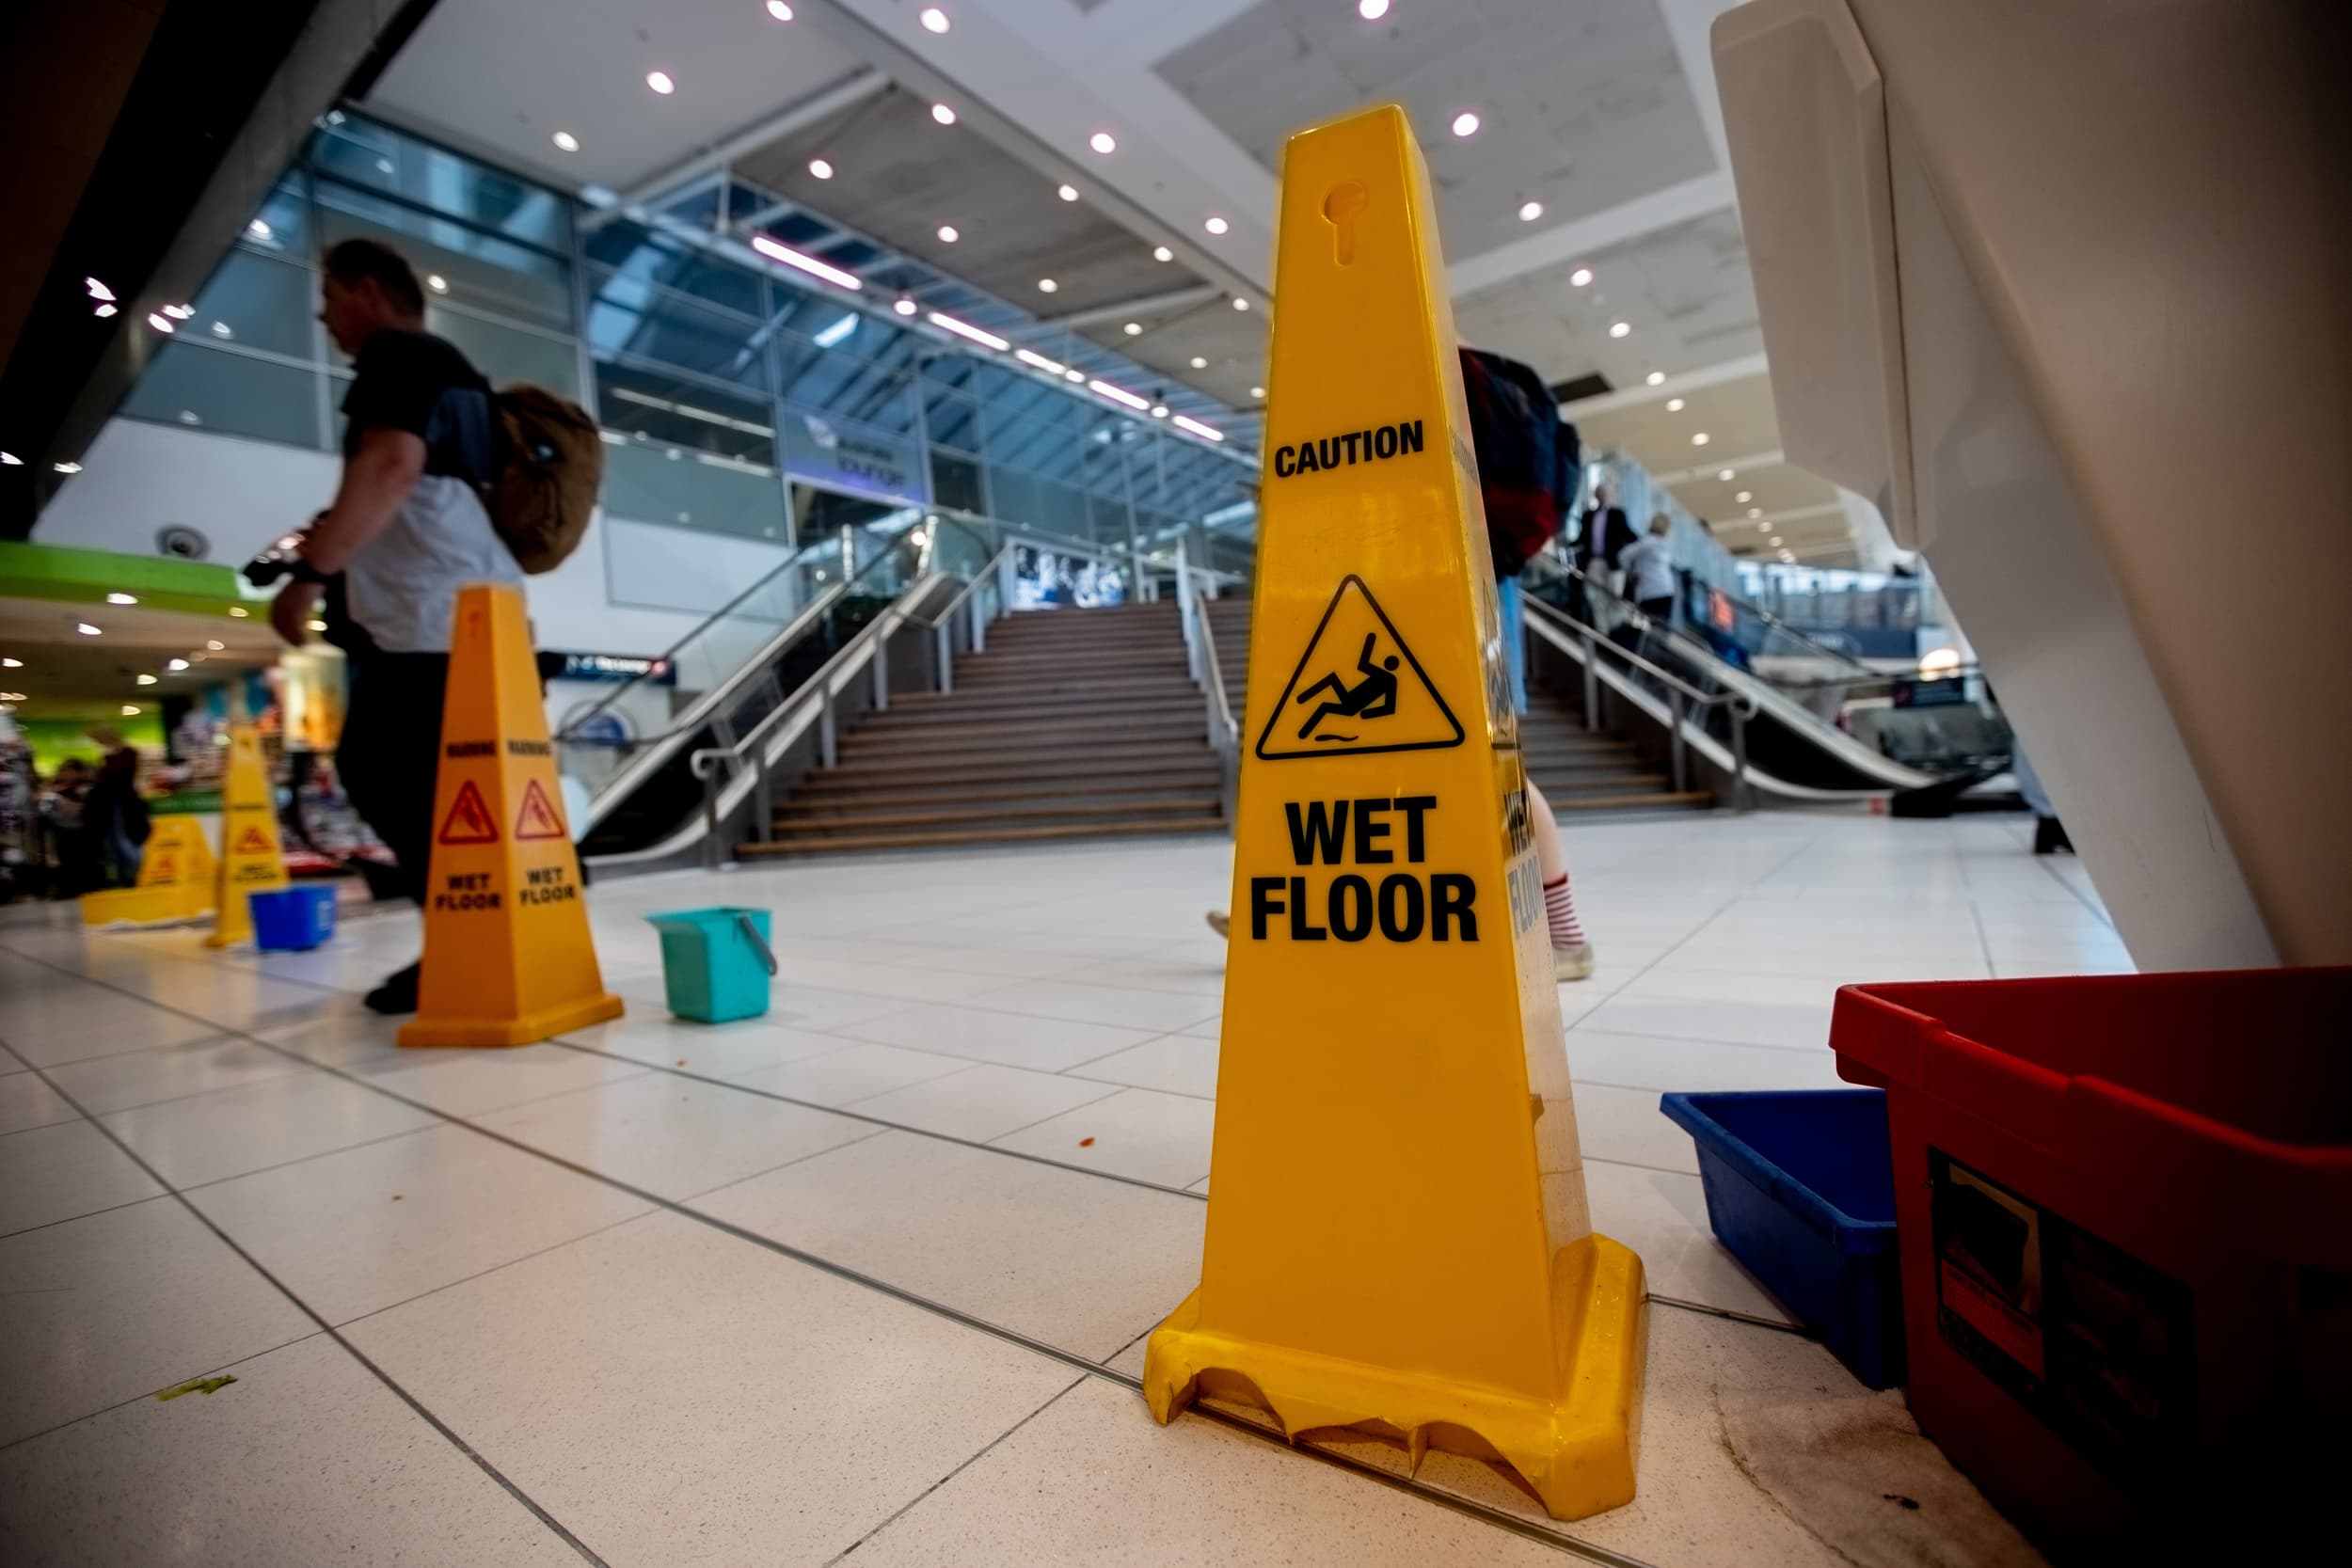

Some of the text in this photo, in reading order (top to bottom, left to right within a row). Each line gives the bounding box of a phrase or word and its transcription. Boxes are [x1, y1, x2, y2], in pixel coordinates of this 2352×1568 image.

[1275, 420, 1423, 478] CAUTION
[1285, 796, 1438, 866] WET
[449, 874, 490, 890] WET
[527, 867, 563, 885] WET
[436, 895, 501, 911] FLOOR
[520, 885, 575, 906] FLOOR
[1251, 873, 1480, 942] FLOOR
